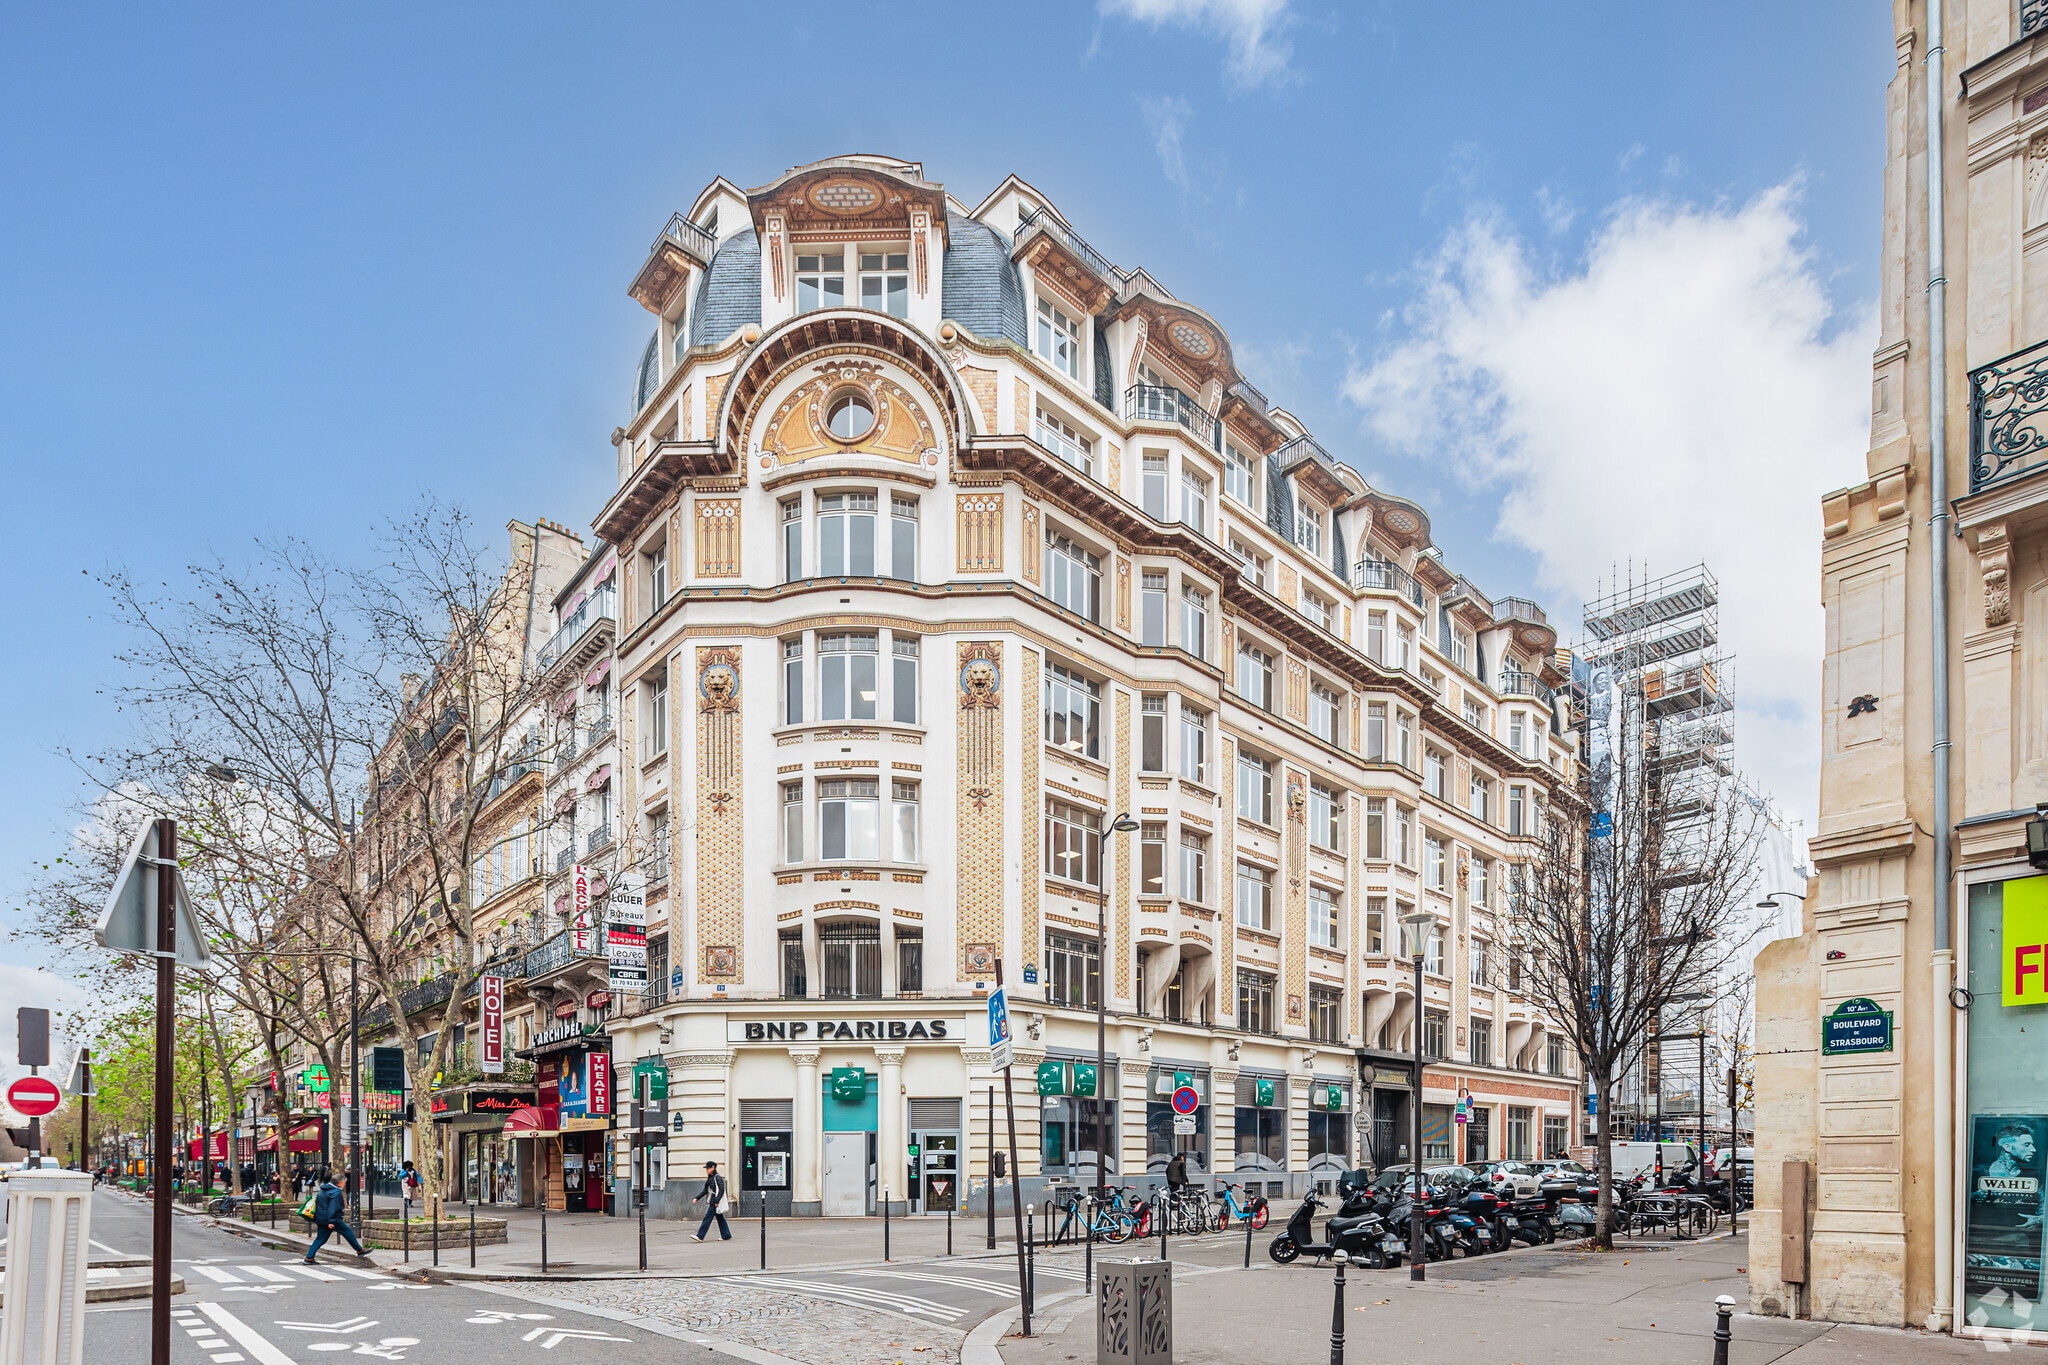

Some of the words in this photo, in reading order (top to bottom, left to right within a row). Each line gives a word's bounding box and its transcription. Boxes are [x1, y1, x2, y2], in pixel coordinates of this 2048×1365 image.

[611, 894, 643, 906] LOUER
[610, 909, 644, 920] Bureaux
[612, 947, 644, 959] Leaseo
[617, 971, 639, 979] CBRE
[485, 978, 500, 1060] HOTEL
[1833, 1018, 1882, 1030] BOULEVARD
[531, 1022, 581, 1047] L'ARCHIPEL
[745, 1022, 808, 1039] BNP
[817, 1020, 948, 1039] PARIBAS
[1829, 1036, 1885, 1047] STRASBOURG
[593, 1055, 606, 1112] THEATRE
[476, 1097, 506, 1109] Miss
[1984, 1179, 2030, 1190] WAHL
